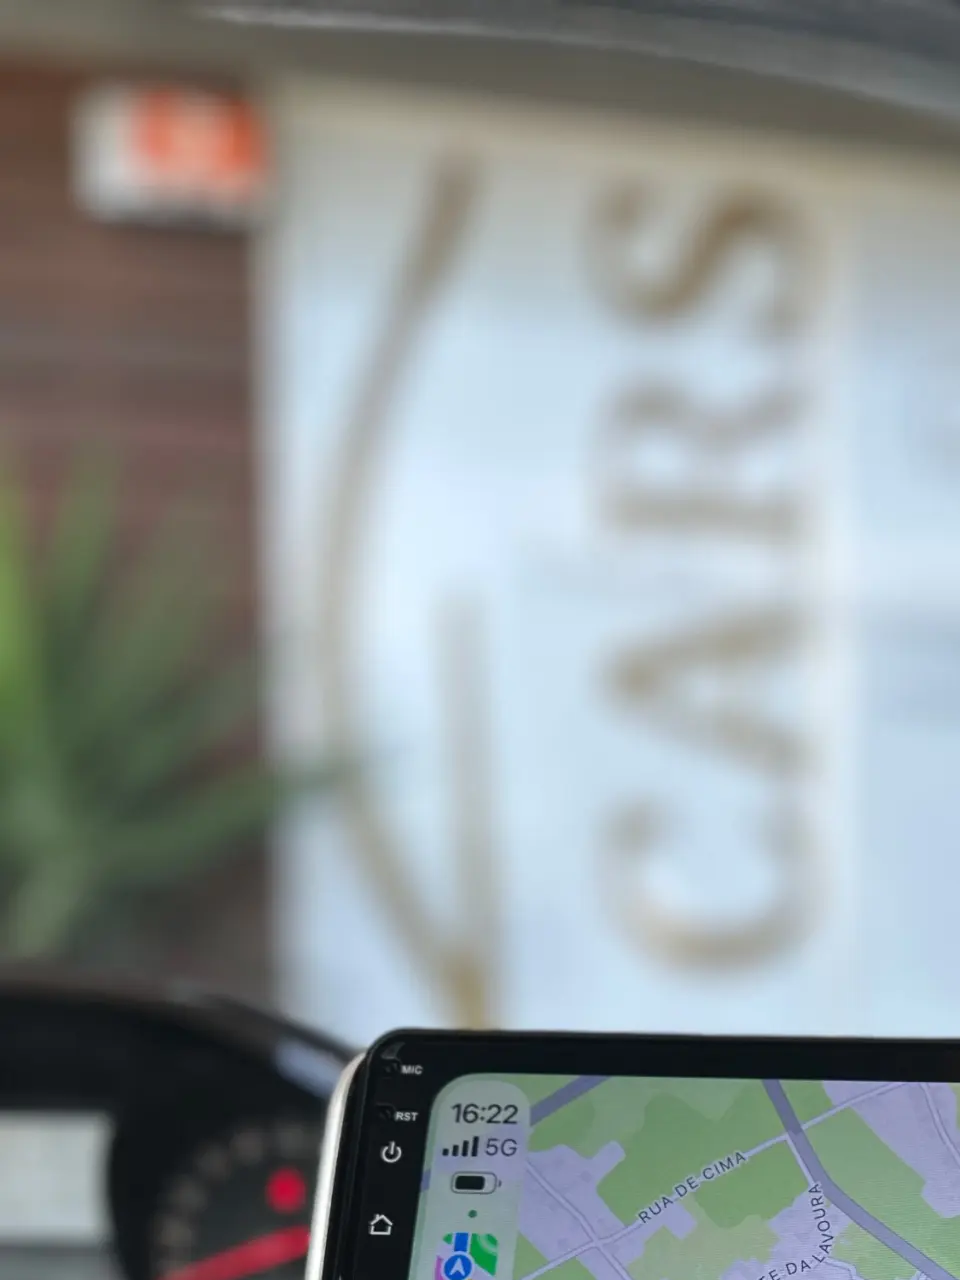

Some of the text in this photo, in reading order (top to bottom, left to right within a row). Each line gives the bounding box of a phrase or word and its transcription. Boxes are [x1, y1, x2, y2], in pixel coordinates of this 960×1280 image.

[401, 1065, 423, 1075] MIC
[395, 1112, 418, 1121] RST
[451, 1103, 519, 1124] 16:22
[485, 1138, 517, 1157] 5G
[638, 1151, 747, 1223] RUA DE CIMA
[785, 1260, 811, 1276] DA
[808, 1183, 834, 1263] LAVOURA
